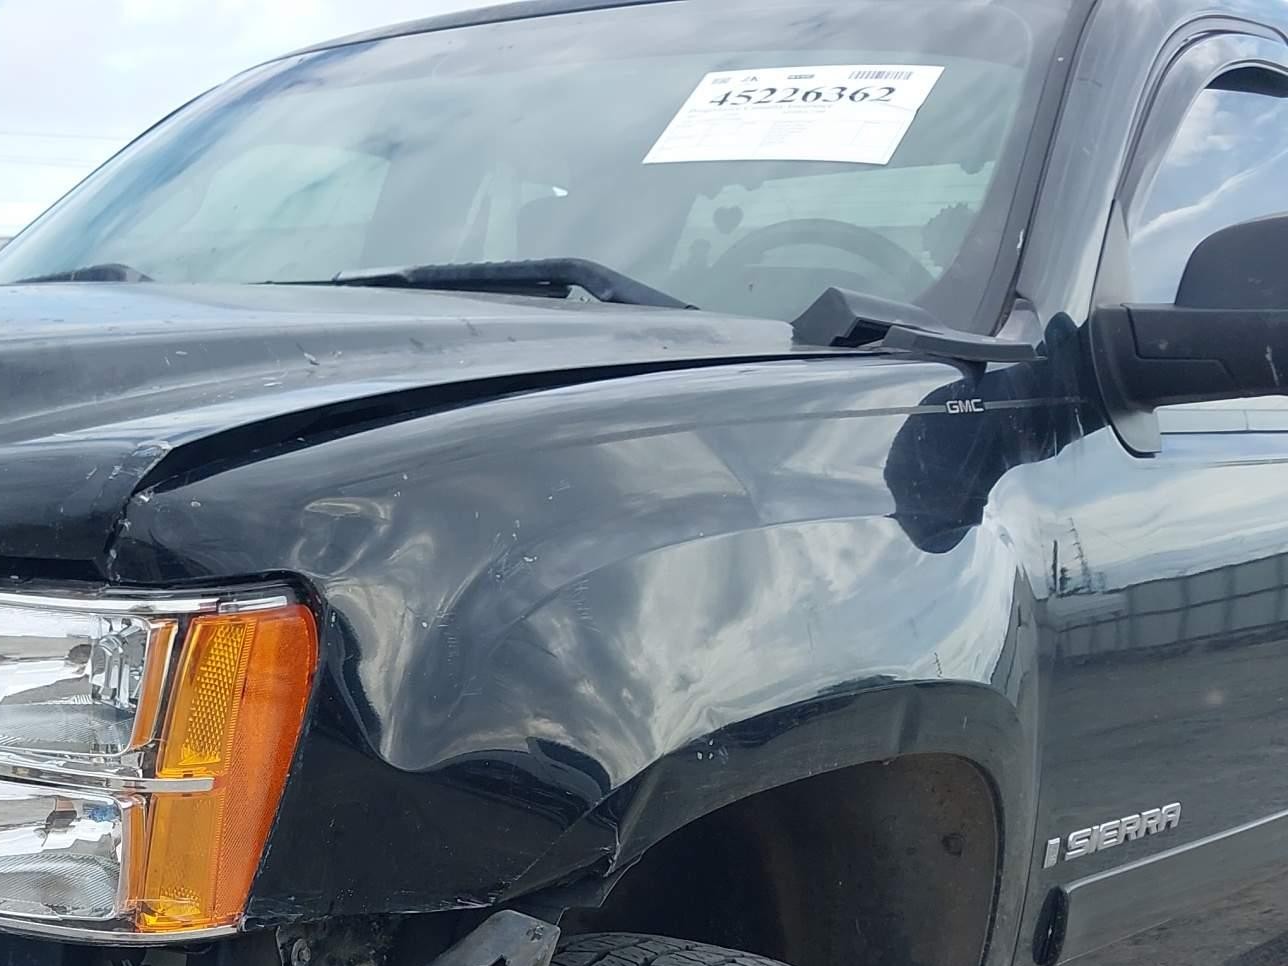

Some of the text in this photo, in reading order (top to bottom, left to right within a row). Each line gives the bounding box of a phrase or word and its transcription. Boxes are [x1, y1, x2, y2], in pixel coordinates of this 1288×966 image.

[709, 85, 896, 106] 45226362
[946, 399, 984, 413] GMC
[1064, 802, 1182, 861] SIERRA
